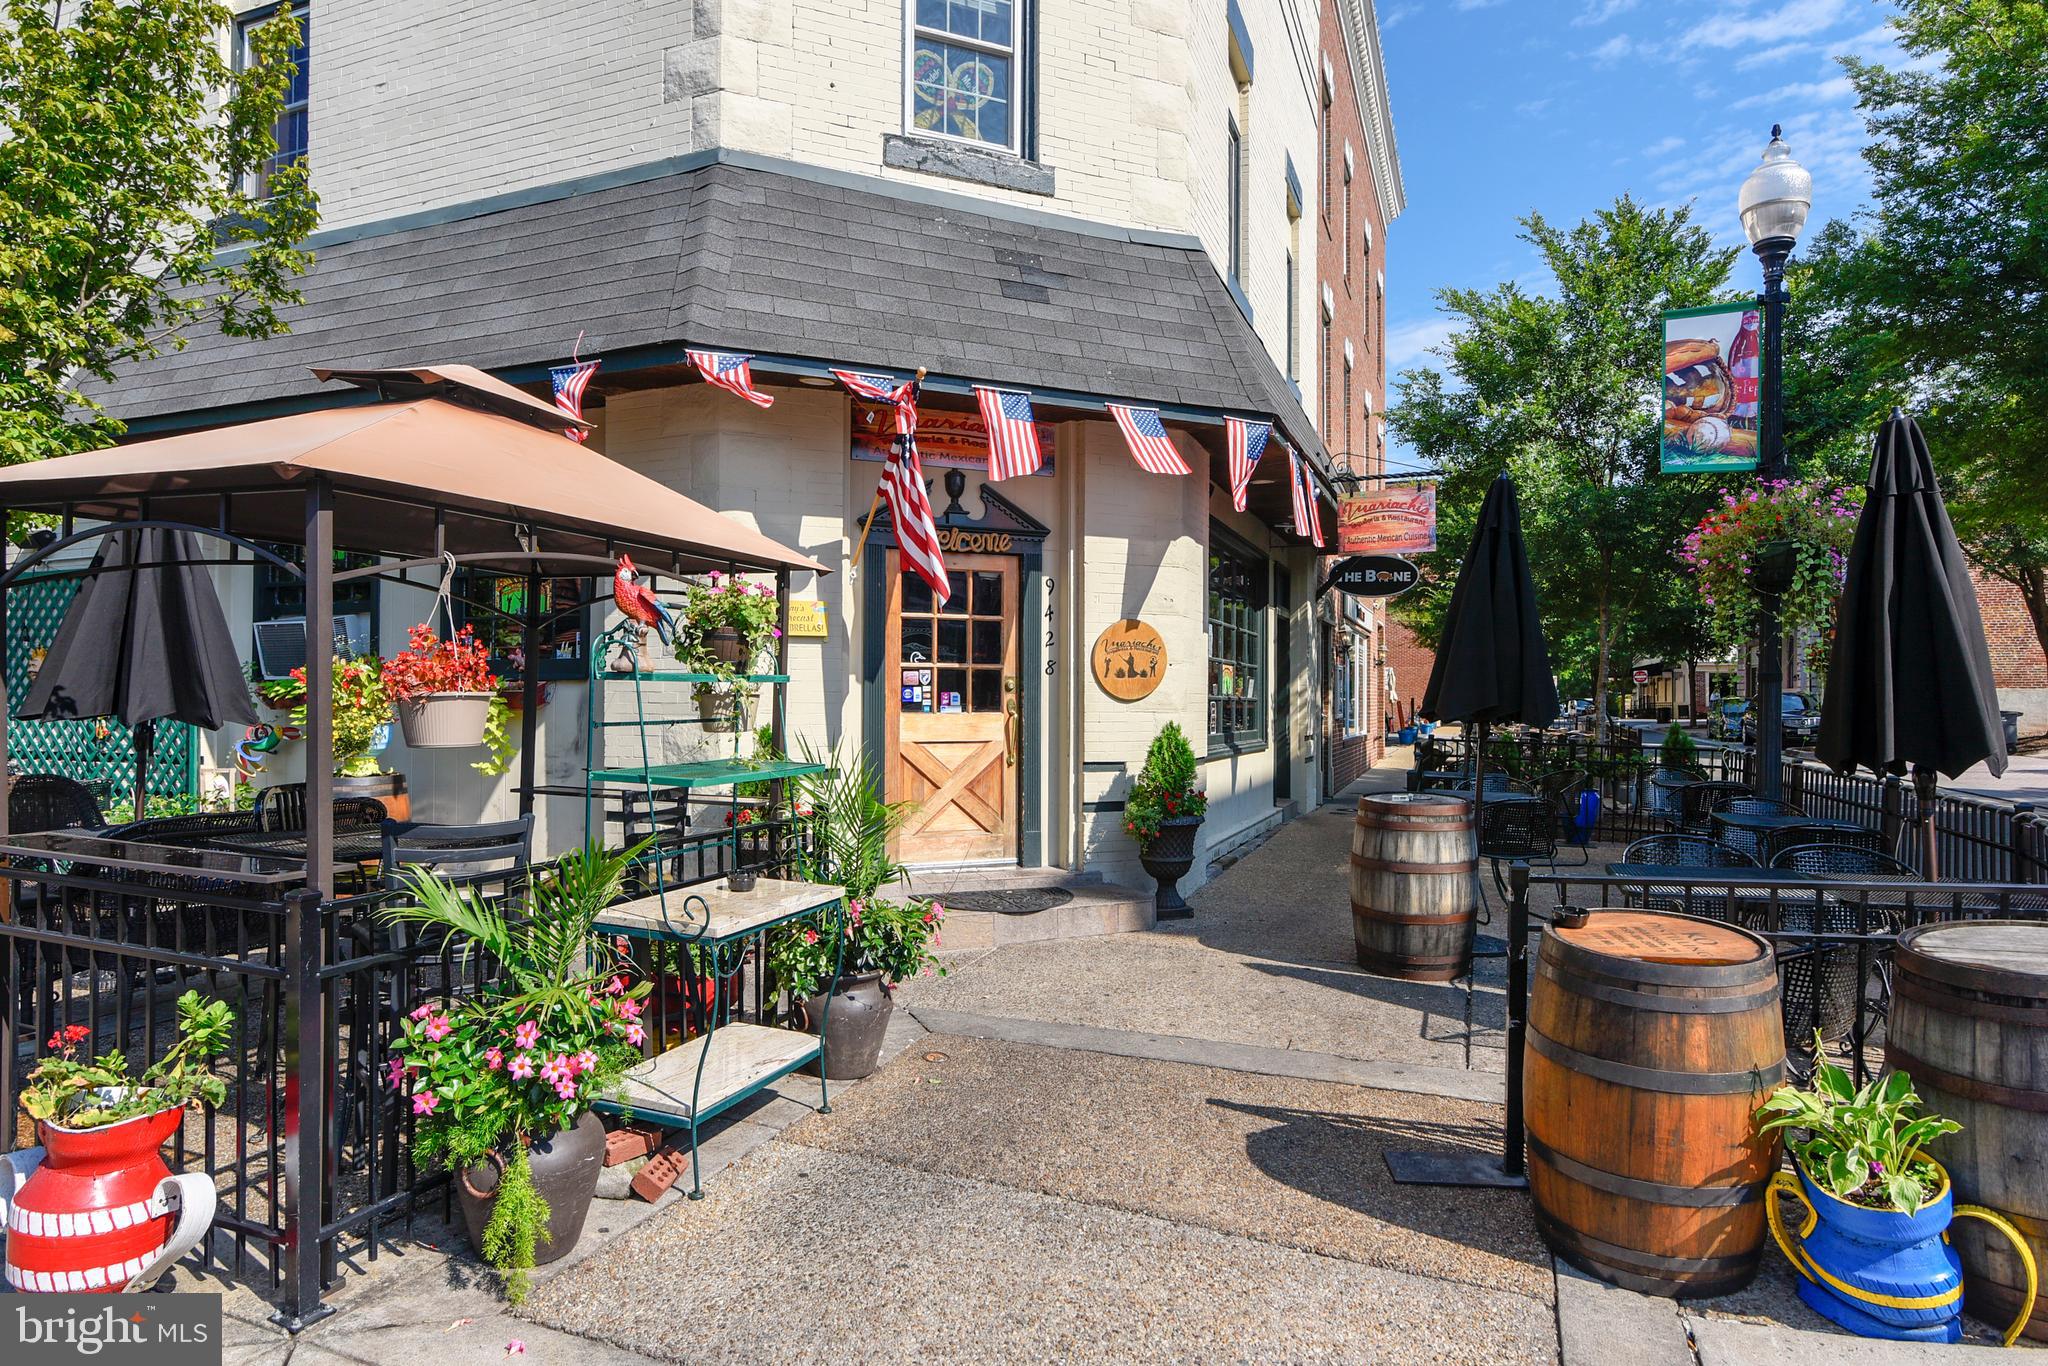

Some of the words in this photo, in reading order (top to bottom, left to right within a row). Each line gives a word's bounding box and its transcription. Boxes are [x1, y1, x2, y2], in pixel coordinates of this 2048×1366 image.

[936, 527, 1013, 553] elcome
[1347, 534, 1376, 545] Authentic
[1378, 533, 1403, 543] Mexican
[1404, 531, 1428, 541] Cuisine
[1336, 570, 1362, 582] HE
[1045, 578, 1057, 676] 9428
